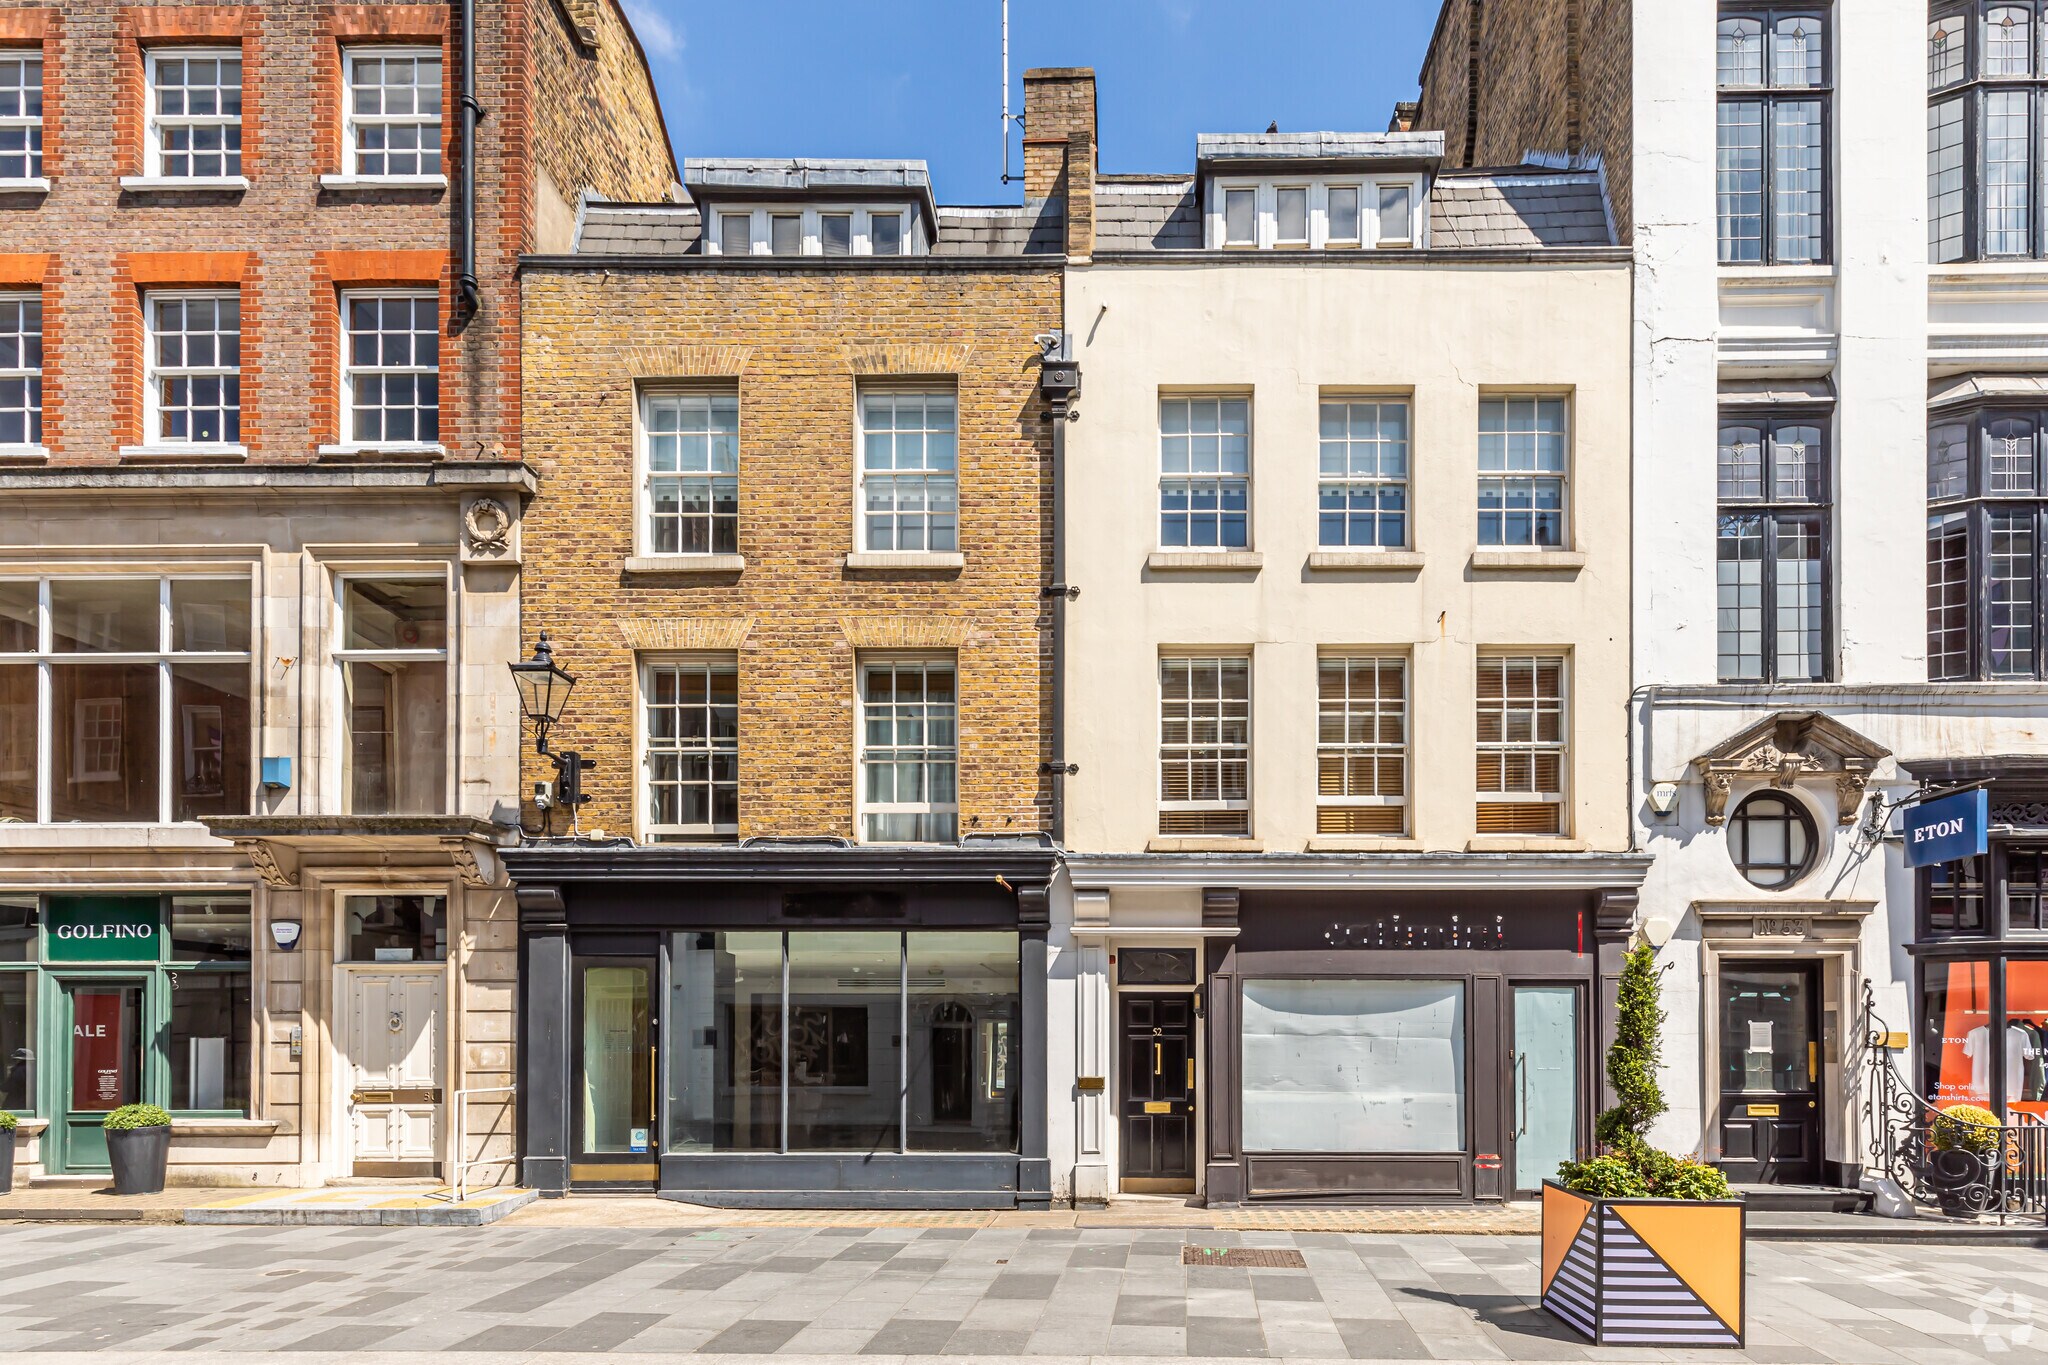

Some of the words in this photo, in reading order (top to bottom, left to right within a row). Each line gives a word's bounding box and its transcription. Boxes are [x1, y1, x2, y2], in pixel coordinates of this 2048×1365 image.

[1914, 818, 1964, 843] ETON
[57, 924, 152, 939] GOLFINO
[1783, 919, 1804, 935] 53
[74, 1024, 106, 1037] ALE
[1152, 1027, 1163, 1036] 52
[2023, 1047, 2041, 1056] THE
[1934, 1081, 1956, 1092] Shop
[1958, 1082, 1980, 1091] onli
